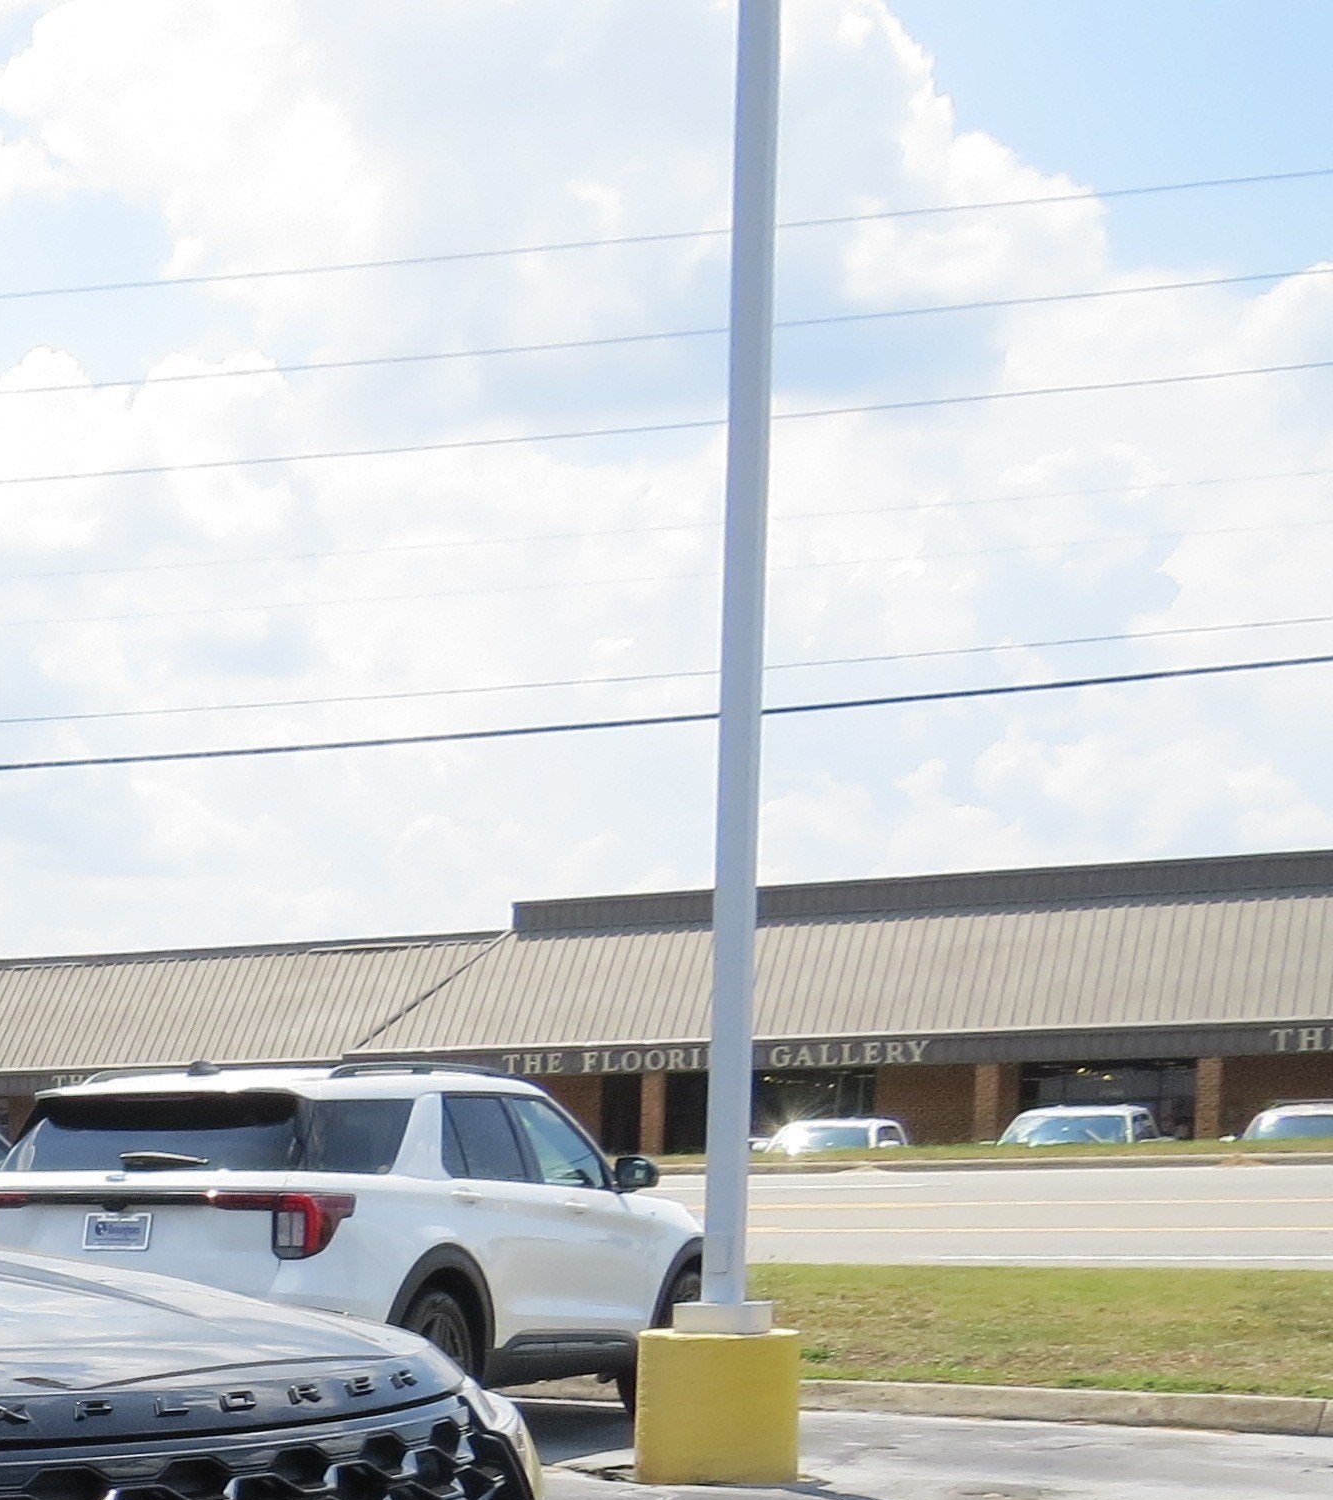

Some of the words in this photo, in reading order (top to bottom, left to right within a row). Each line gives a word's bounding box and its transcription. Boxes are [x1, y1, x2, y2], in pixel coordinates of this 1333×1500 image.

[1269, 1027, 1333, 1052] TH
[502, 1052, 563, 1075] THE
[581, 1047, 709, 1074] FLOORI
[769, 1040, 930, 1068] GALLERY
[52, 1074, 84, 1087] TH
